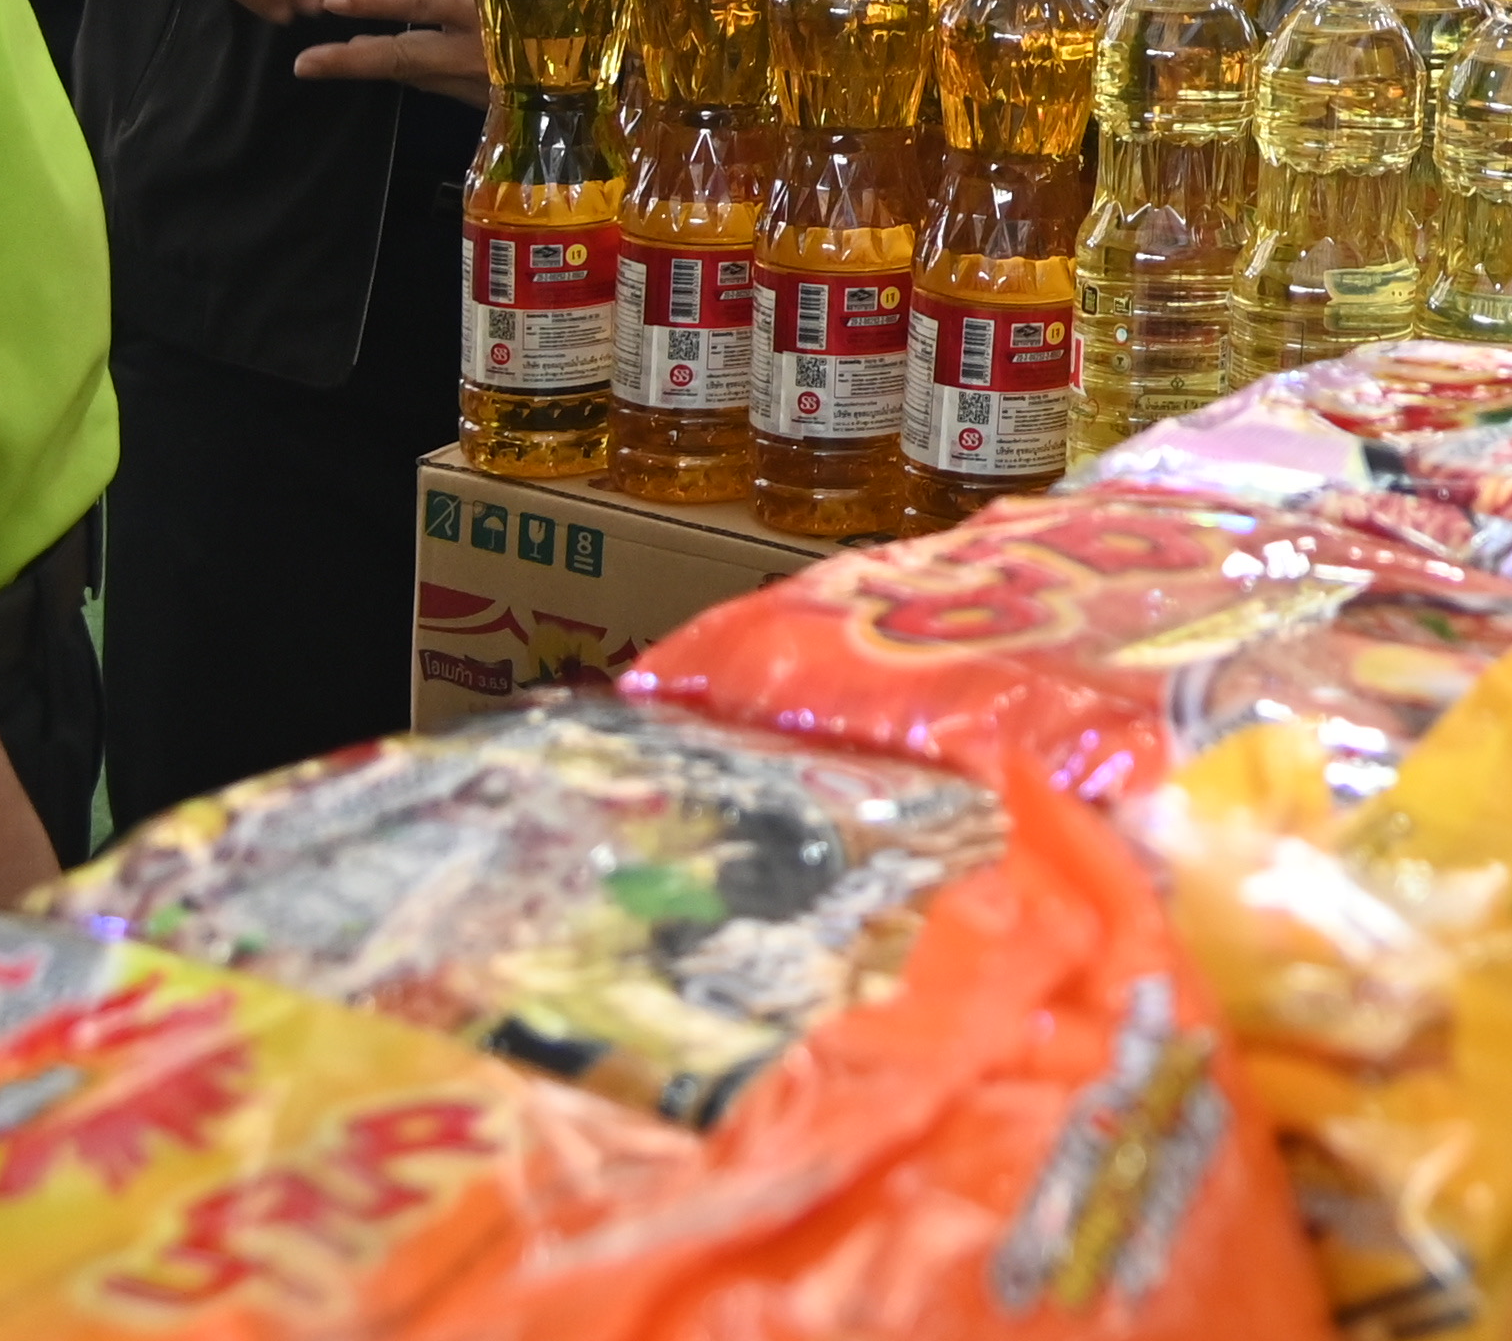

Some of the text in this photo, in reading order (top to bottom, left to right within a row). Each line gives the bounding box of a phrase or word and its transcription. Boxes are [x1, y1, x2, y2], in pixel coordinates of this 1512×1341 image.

[961, 432, 981, 447] SS
[576, 530, 593, 556] 8
[424, 651, 473, 686] โอเมก้า
